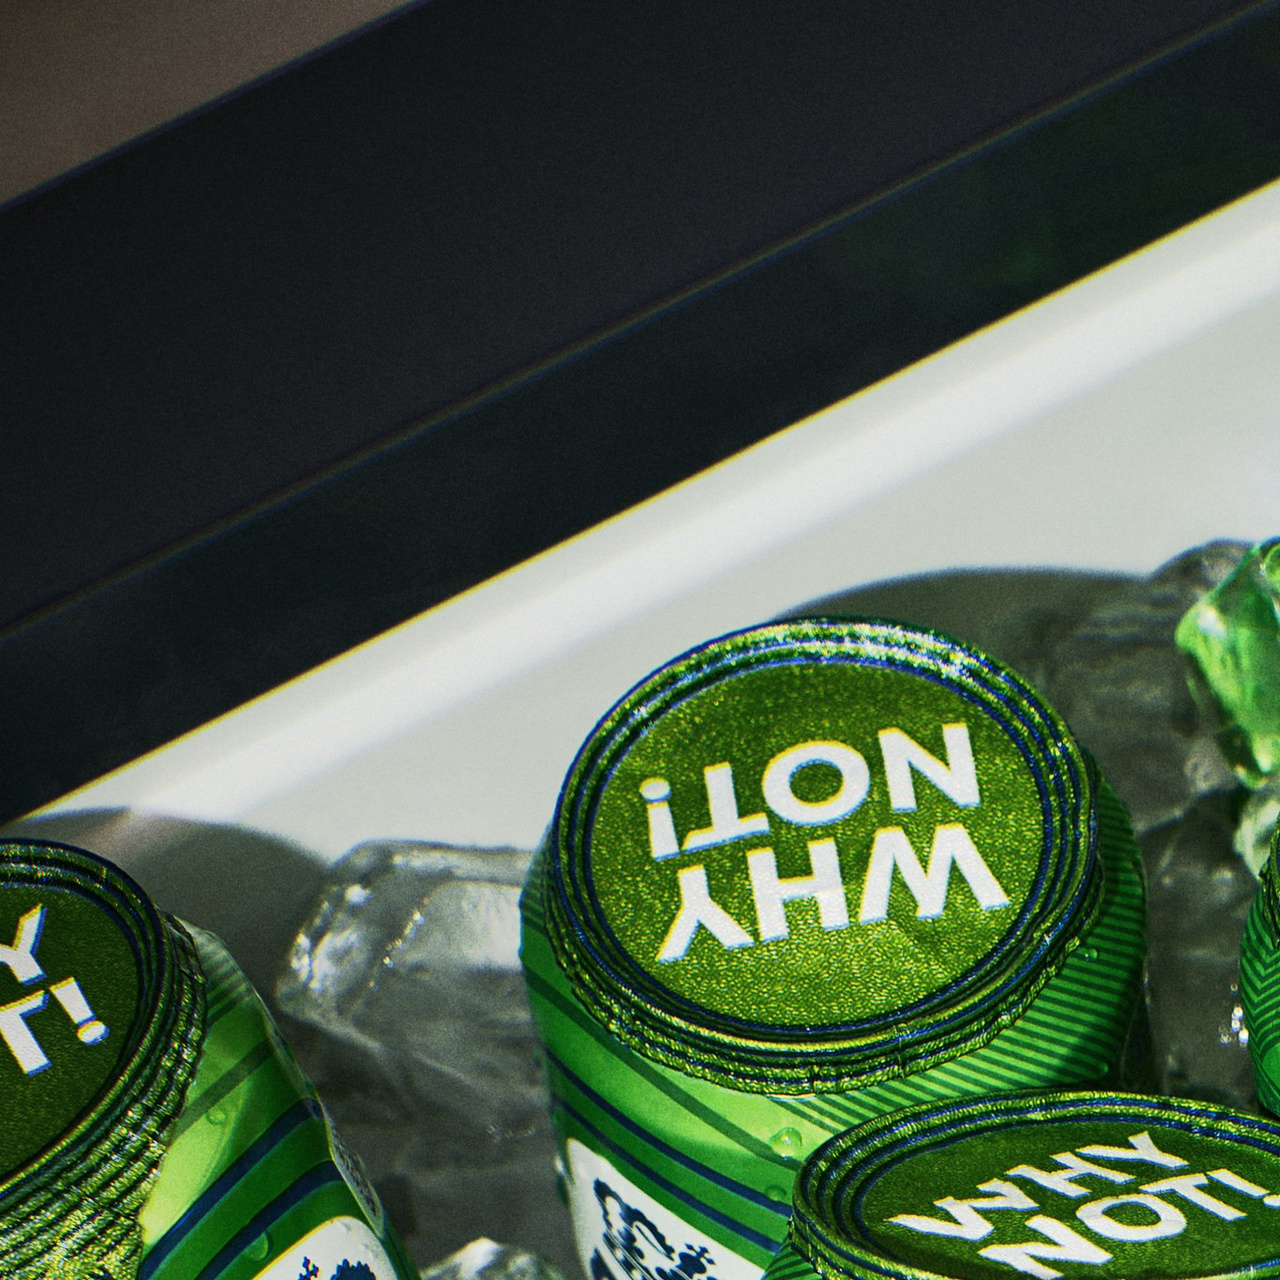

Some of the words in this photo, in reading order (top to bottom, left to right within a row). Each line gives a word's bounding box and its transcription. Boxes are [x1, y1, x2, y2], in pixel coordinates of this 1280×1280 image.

[639, 722, 981, 861] NOT!
[656, 823, 1011, 963] WHY
[884, 1131, 1190, 1242] WHY
